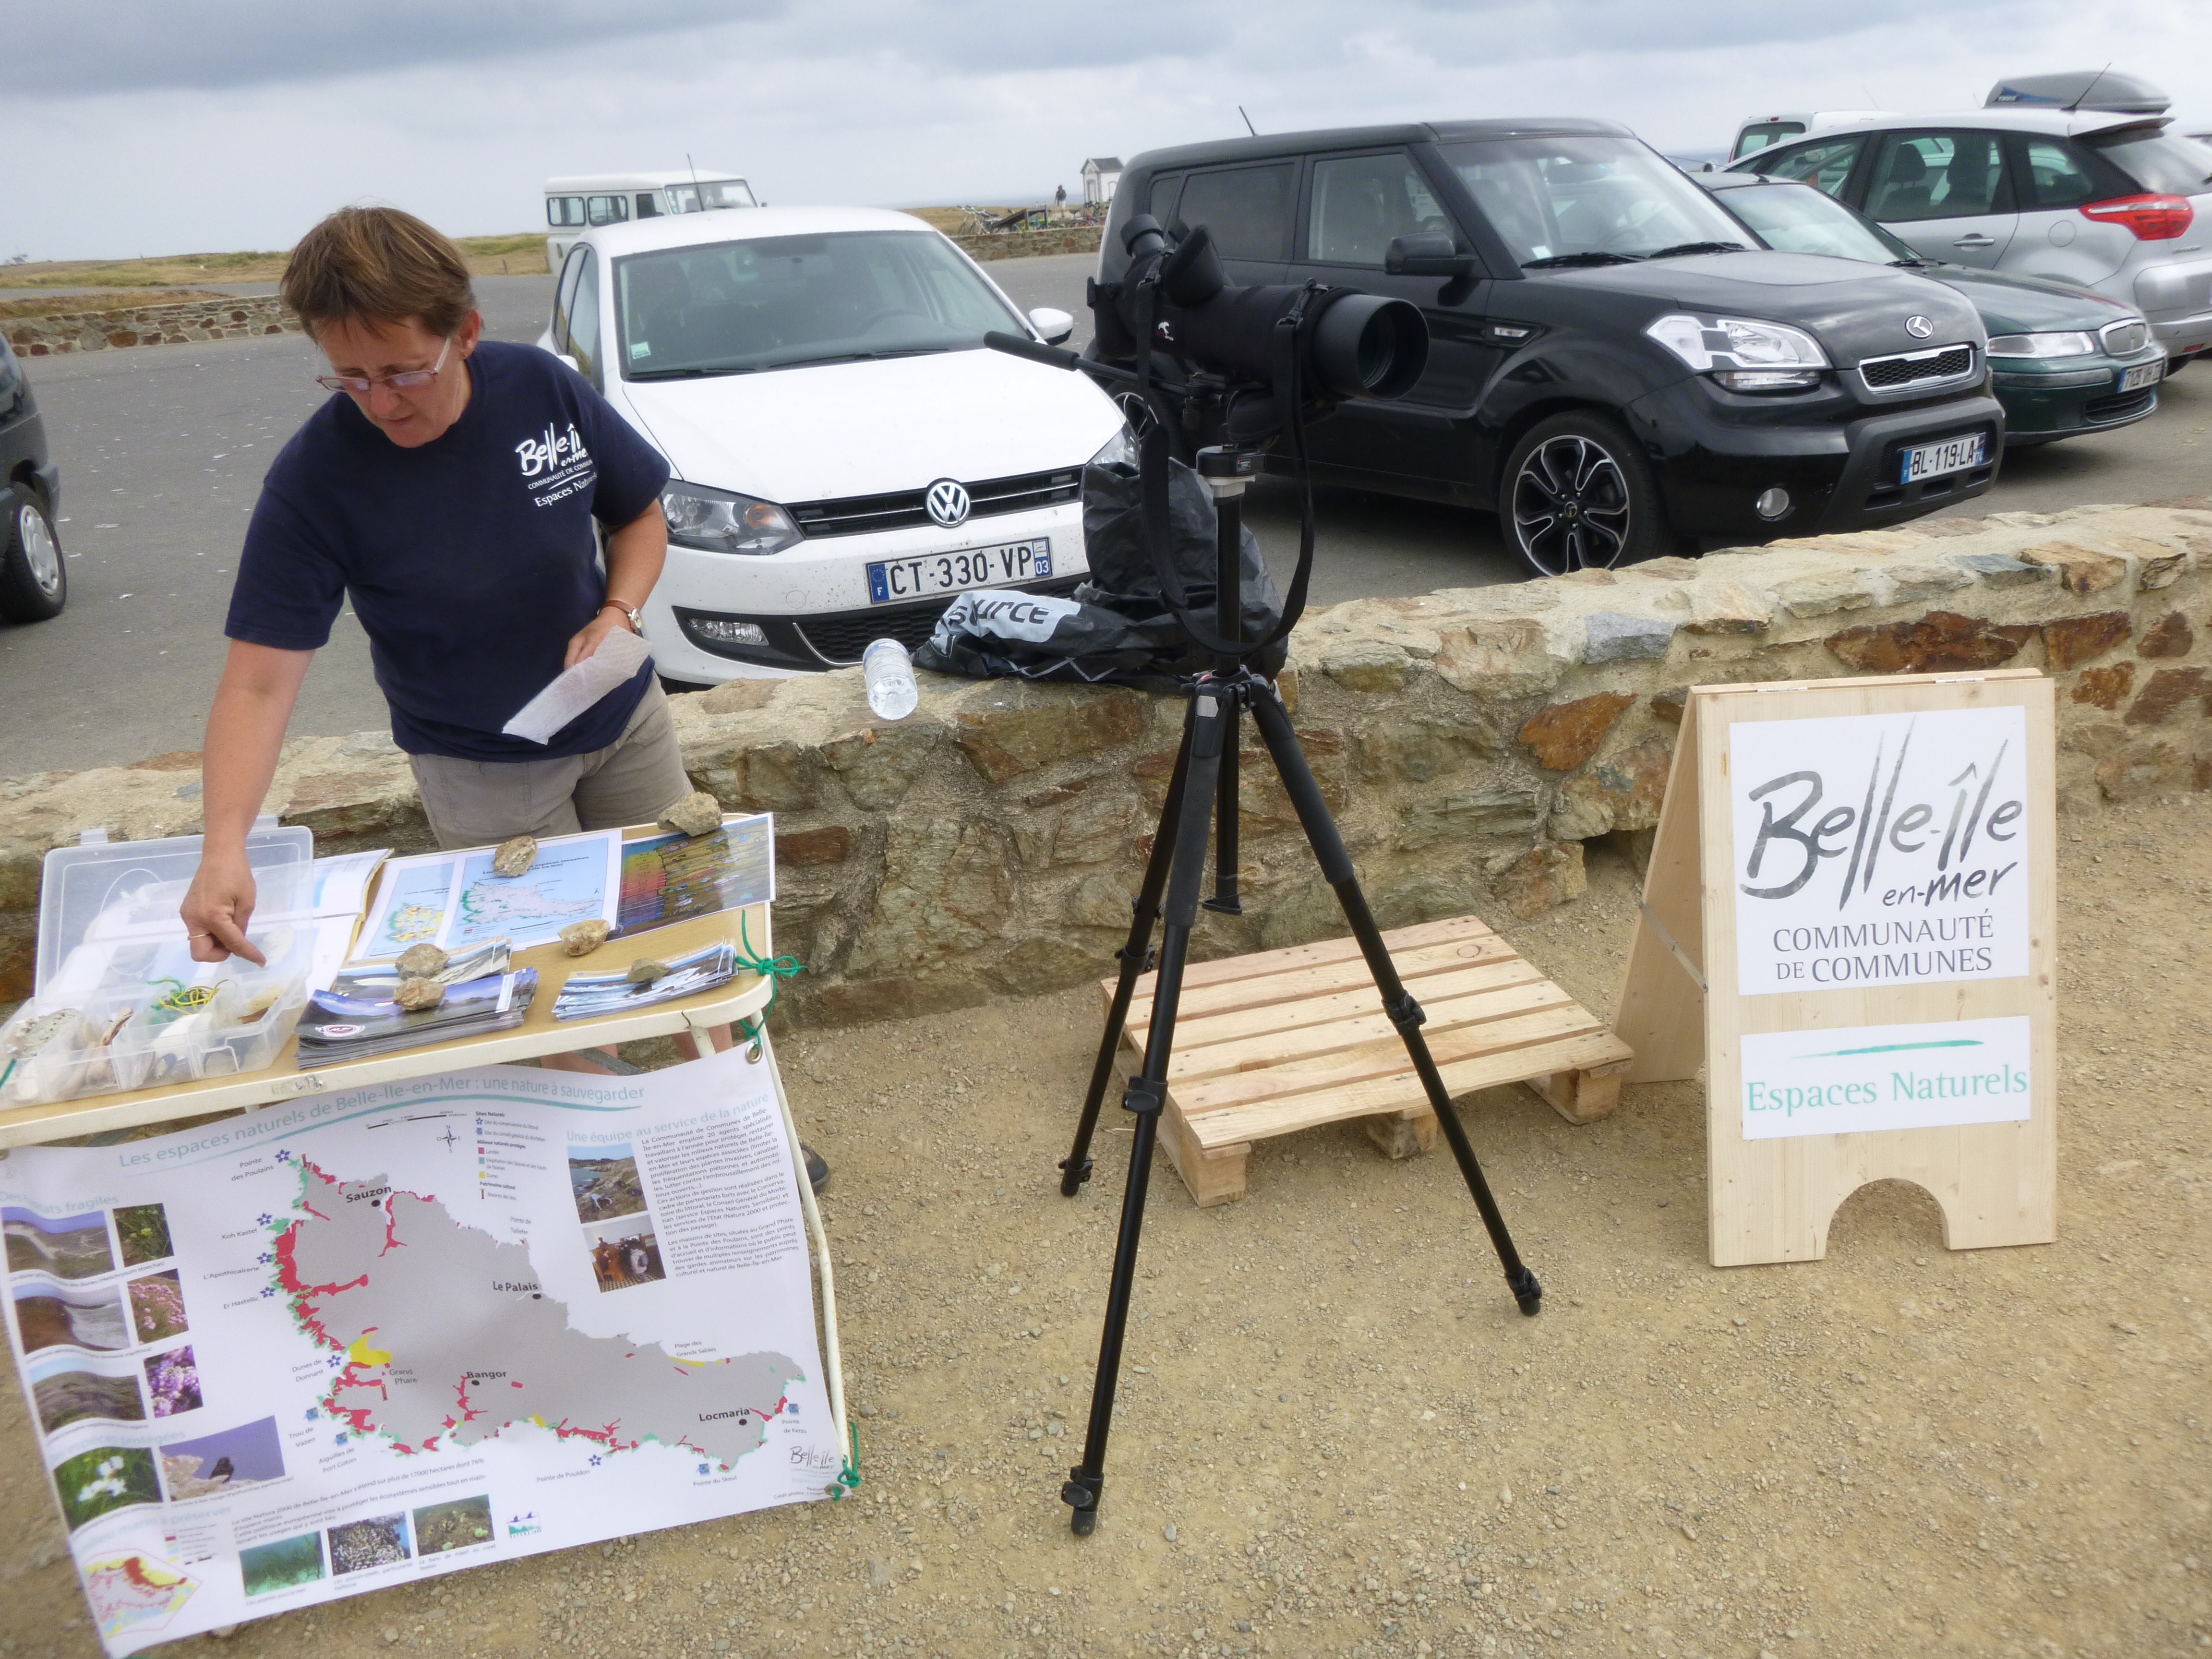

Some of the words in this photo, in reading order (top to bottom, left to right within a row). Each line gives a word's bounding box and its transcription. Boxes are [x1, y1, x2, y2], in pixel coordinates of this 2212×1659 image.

[514, 422, 581, 477] Belle-îl
[561, 448, 589, 467] en-me
[1911, 440, 1974, 476] BL-119-LA
[528, 470, 565, 490] COMMUNAUTÉ
[574, 459, 593, 471] COMMUN
[534, 487, 574, 507] Espaces
[877, 587, 882, 596] F
[890, 545, 1033, 595] CT-330-VP
[1034, 559, 1049, 575] 03
[1773, 908, 1994, 952] COMMUNAUTÉ
[1776, 962, 1804, 981] DE
[1811, 947, 1993, 983] COMMUNES
[1745, 1081, 1877, 1117] Espaces
[1890, 1064, 2027, 1101] Naturels
[119, 1153, 150, 1167] Les
[156, 1134, 229, 1159] espaces
[235, 1110, 306, 1141] naturels
[310, 1104, 331, 1118] de
[484, 1078, 509, 1090] une
[511, 1079, 548, 1094] nature
[552, 1081, 557, 1095] à
[561, 1087, 644, 1104] sauvegarder
[567, 1130, 587, 1142] Une
[590, 1131, 632, 1147] équipe
[637, 1127, 651, 1137] au
[654, 1117, 697, 1132] service
[701, 1112, 715, 1123] de
[720, 1108, 730, 1118] la
[733, 1094, 769, 1115] nature
[651, 1130, 693, 1142] Communauté
[706, 1119, 740, 1130] Communes
[752, 1109, 767, 1118] Belle-
[679, 1135, 703, 1143] emploie
[743, 1115, 771, 1130] spécialisés
[645, 1148, 675, 1158] travaillant
[721, 1133, 748, 1142] protéger,
[749, 1123, 773, 1135] restaurer
[696, 1153, 720, 1161] espèces
[751, 1140, 770, 1150] (limiter
[239, 1158, 262, 1168] Pointe
[650, 1167, 687, 1178] prolifération
[701, 1159, 723, 1167] plantes
[754, 1145, 778, 1156] canaliser
[663, 1169, 707, 1182] fréquentations
[709, 1164, 739, 1172] piétonnes
[750, 1152, 780, 1164] automobi-
[244, 1165, 274, 1178] Poulains
[346, 1186, 392, 1203] Sauzon
[237, 1228, 258, 1237] Kastel
[493, 1280, 504, 1291] Le
[505, 1282, 539, 1292] Palais
[292, 1362, 313, 1373] Dunes
[296, 1369, 324, 1382] Donnant
[389, 1368, 414, 1377] Grand
[467, 1370, 507, 1380] Bangor
[395, 1377, 418, 1385] Phare
[699, 1407, 750, 1422] Locmaria
[289, 1430, 305, 1440] Trou
[296, 1437, 316, 1447] Vazen
[319, 1451, 346, 1464] Aiguilles
[323, 1464, 336, 1473] Port
[337, 1457, 357, 1469] Coton
